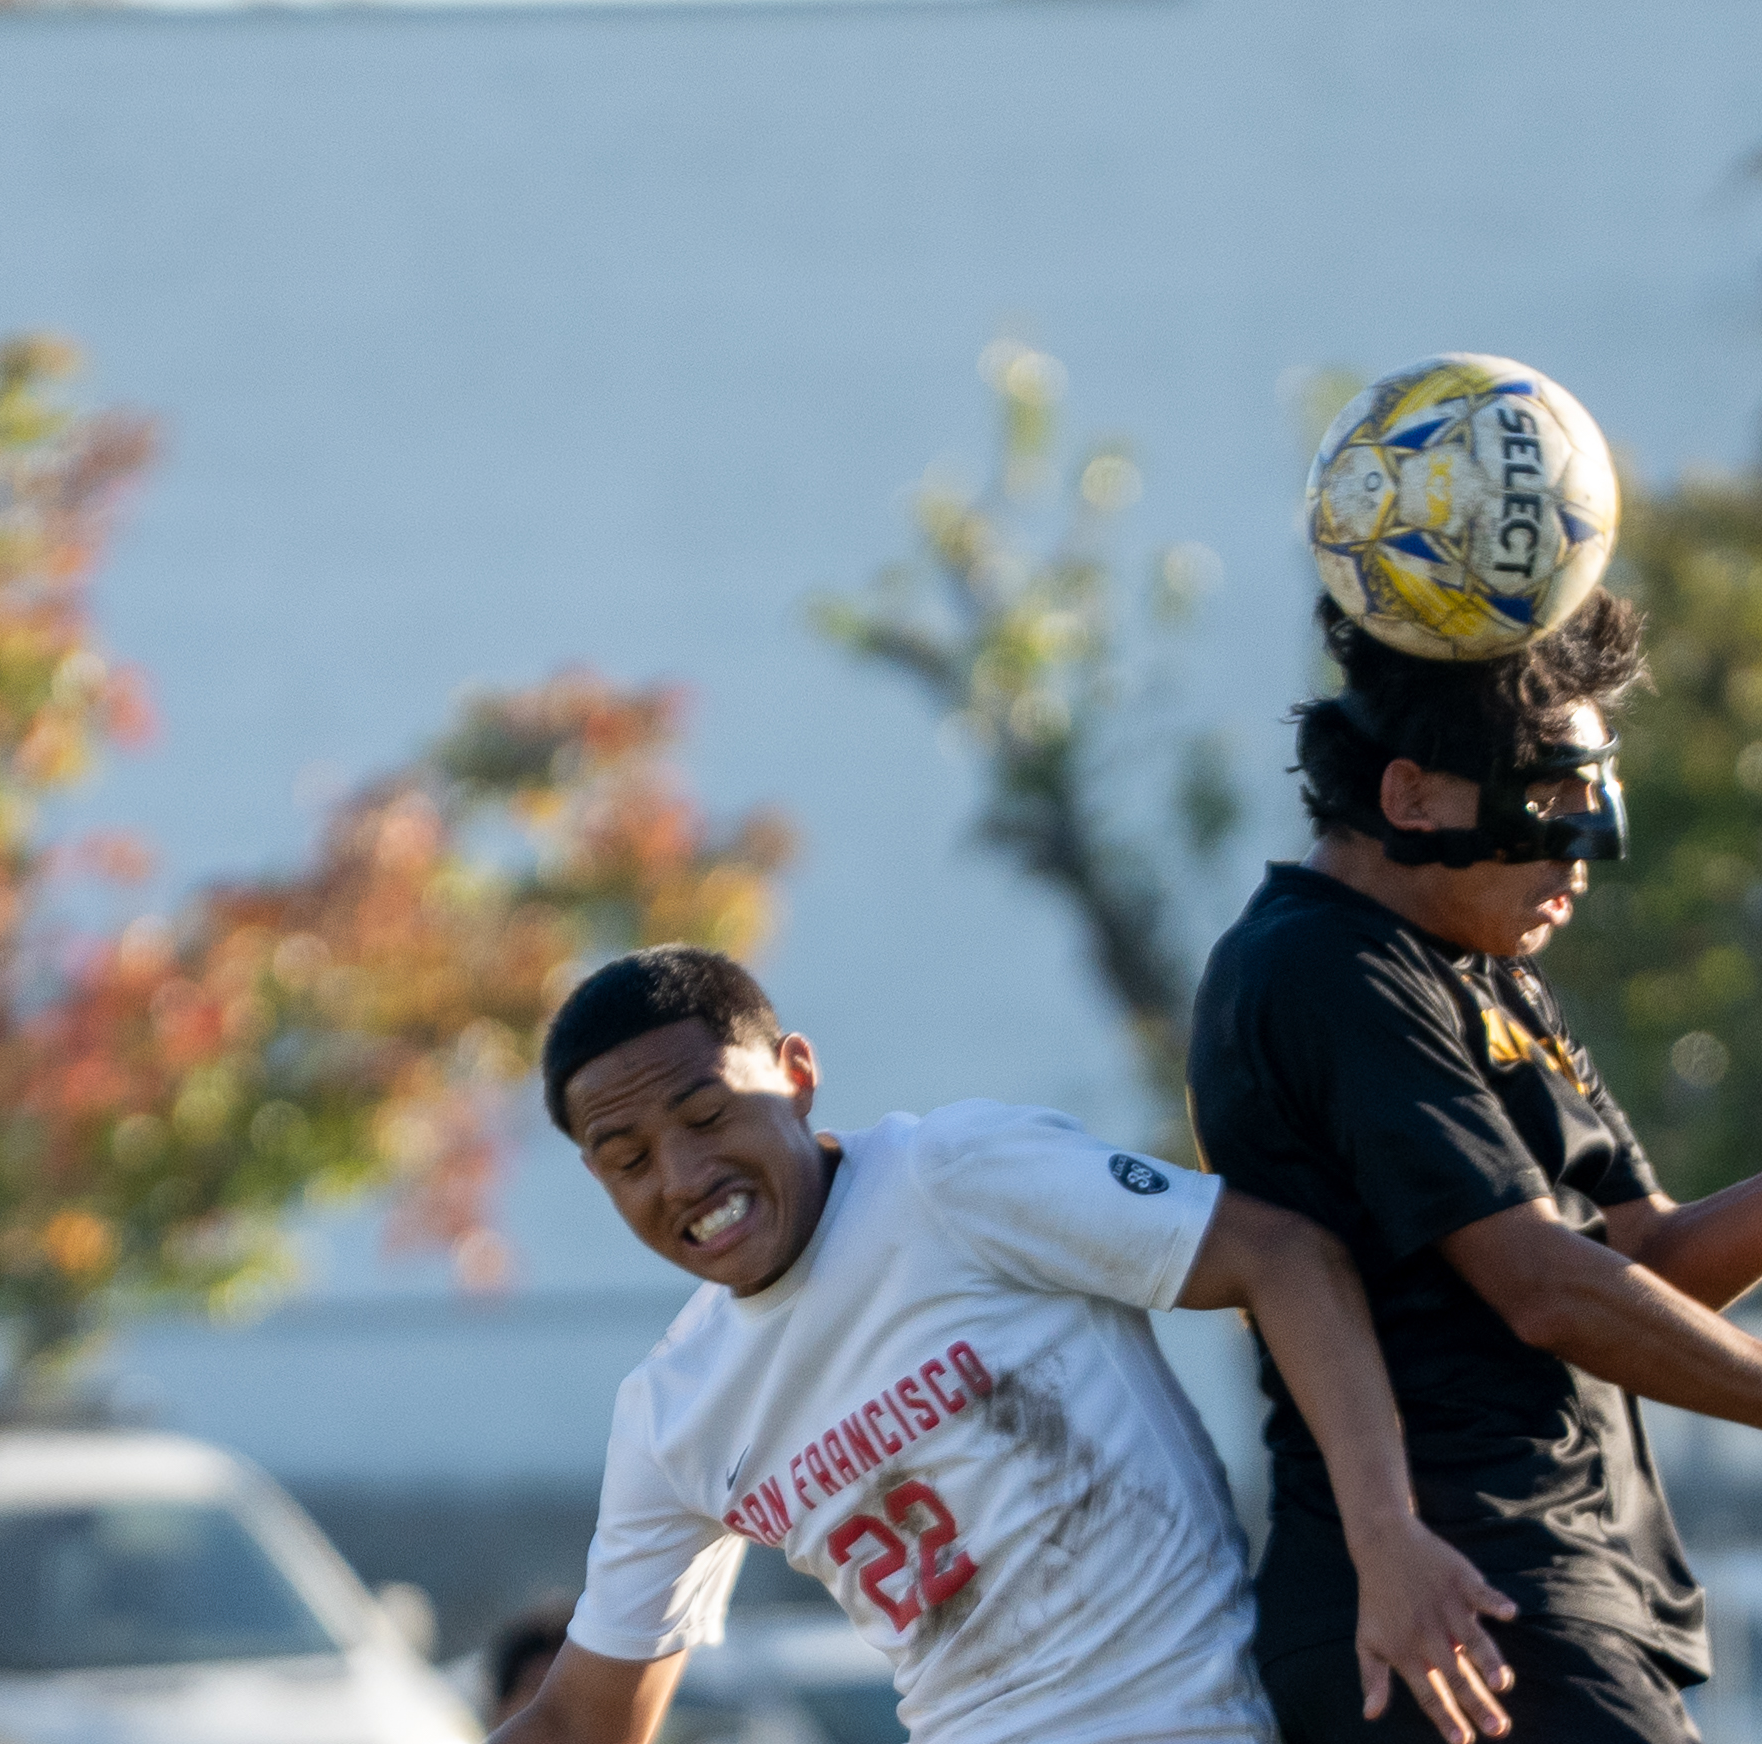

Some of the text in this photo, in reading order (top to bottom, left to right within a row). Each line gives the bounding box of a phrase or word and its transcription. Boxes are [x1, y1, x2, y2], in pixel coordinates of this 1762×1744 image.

[1494, 407, 1542, 579] SELECT
[722, 1340, 993, 1546] SAN FRANCISCO
[827, 1480, 979, 1634] 22
